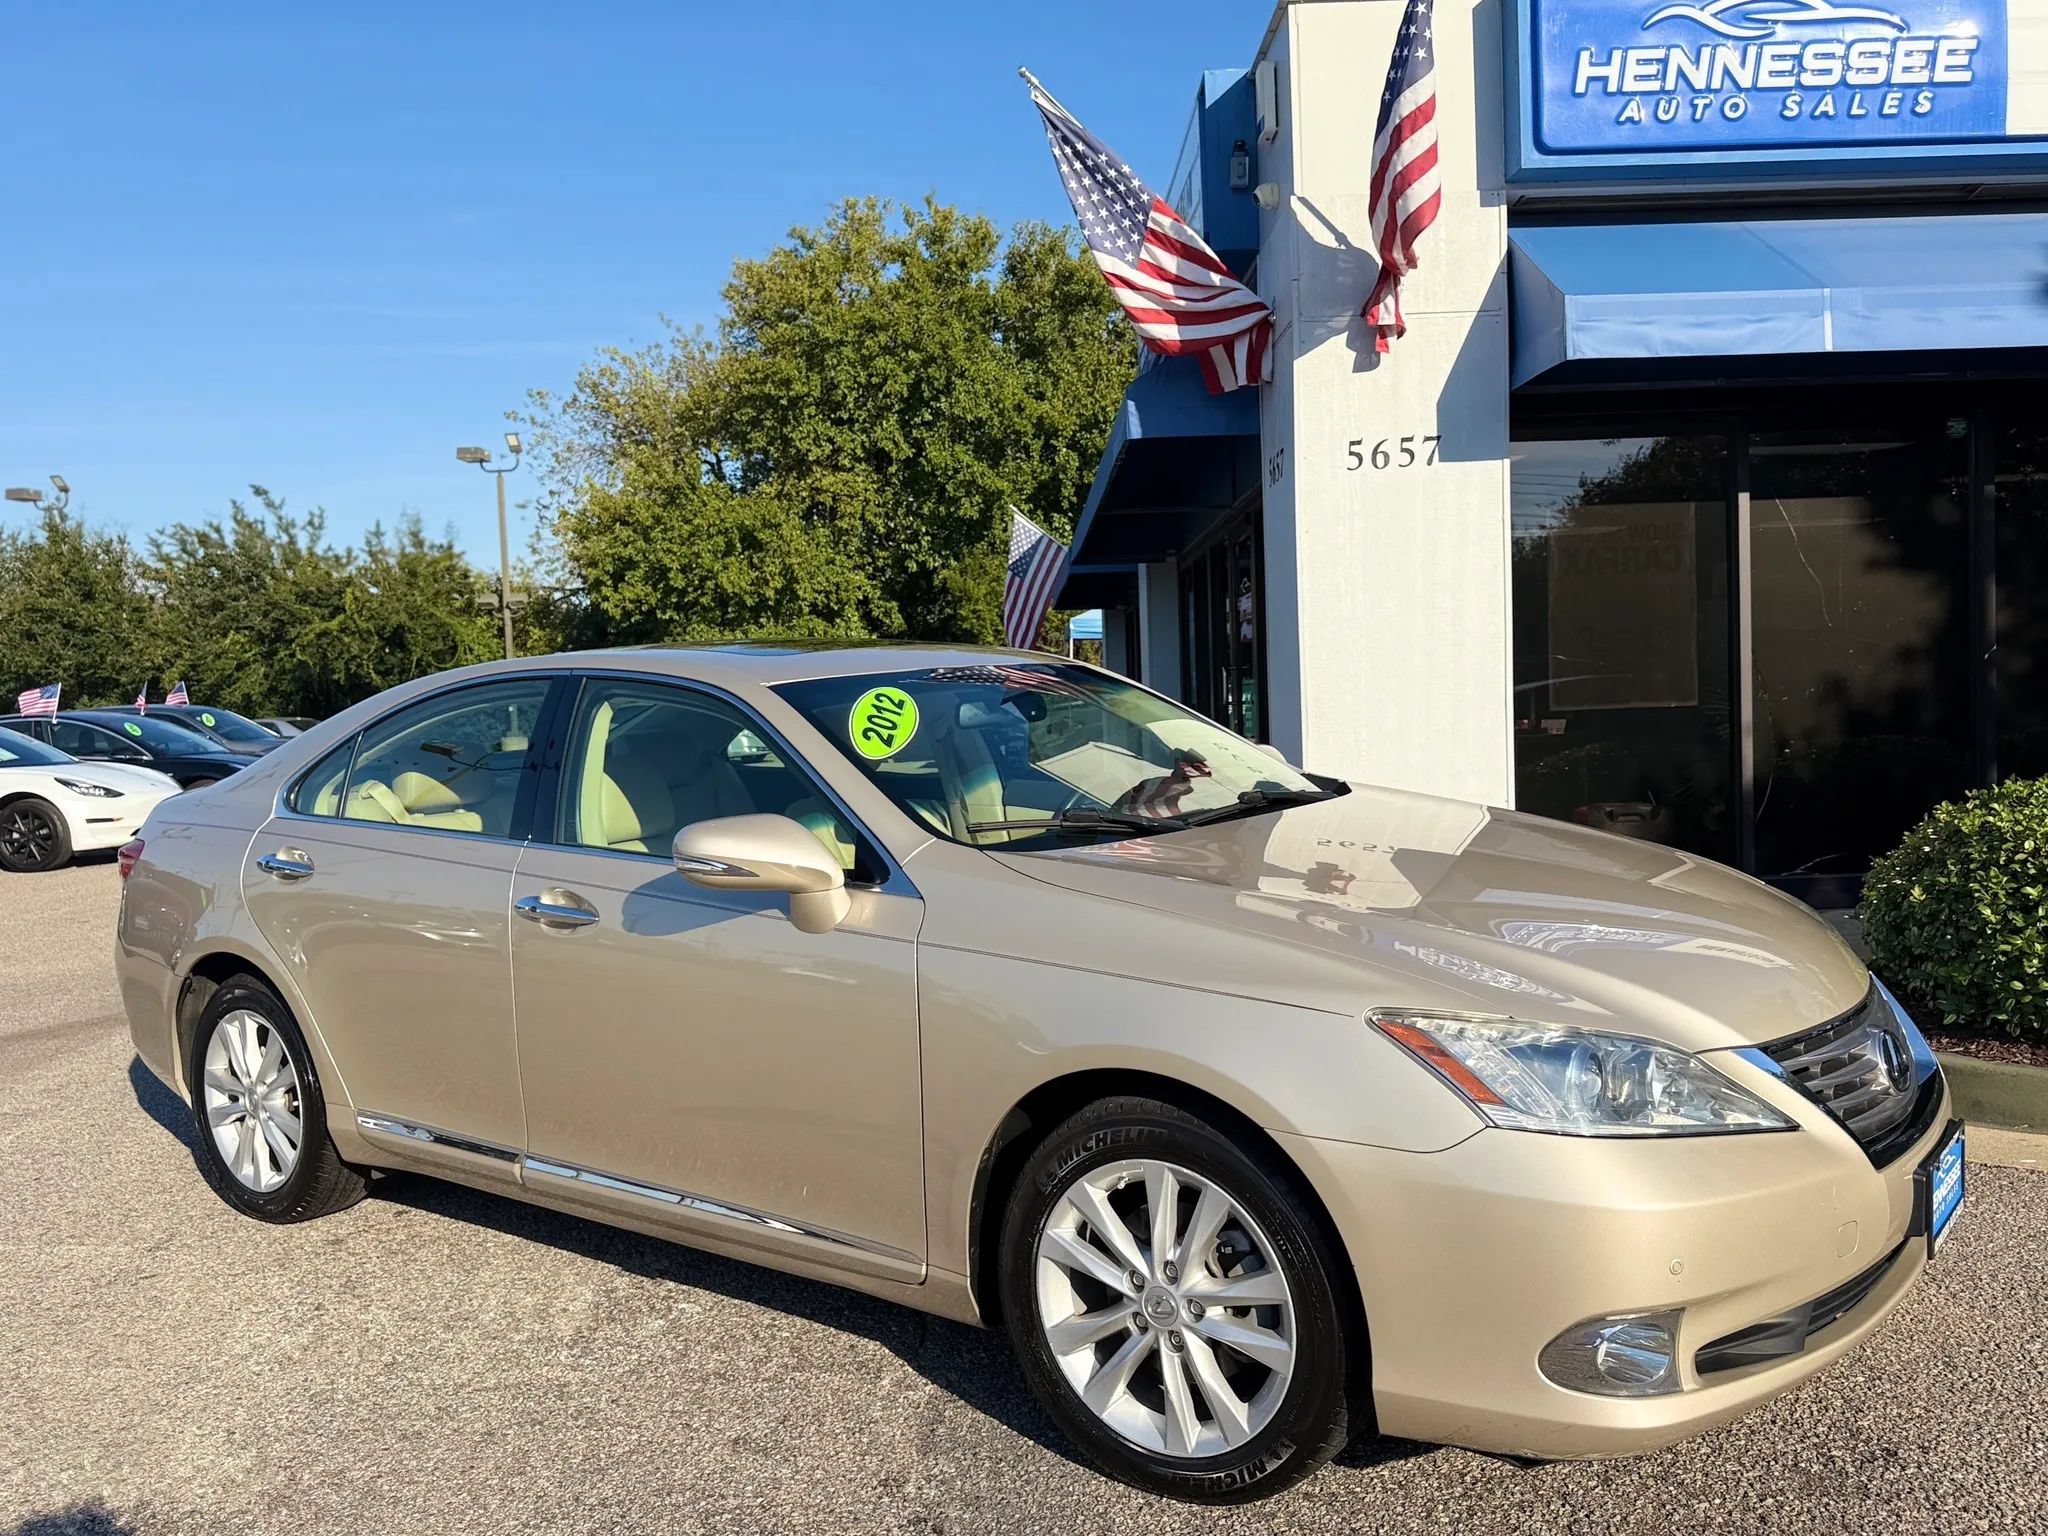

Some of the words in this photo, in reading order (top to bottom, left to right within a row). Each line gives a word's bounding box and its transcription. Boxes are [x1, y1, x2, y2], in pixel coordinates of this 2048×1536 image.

[1575, 36, 1978, 94] HENNESSEE
[1617, 95, 1748, 124] AUTO
[1781, 90, 1935, 119] SALES
[1269, 447, 1285, 488] 5657
[1346, 434, 1442, 471] 5657
[861, 692, 906, 749] 2012
[1056, 1126, 1169, 1173] MICHELIN
